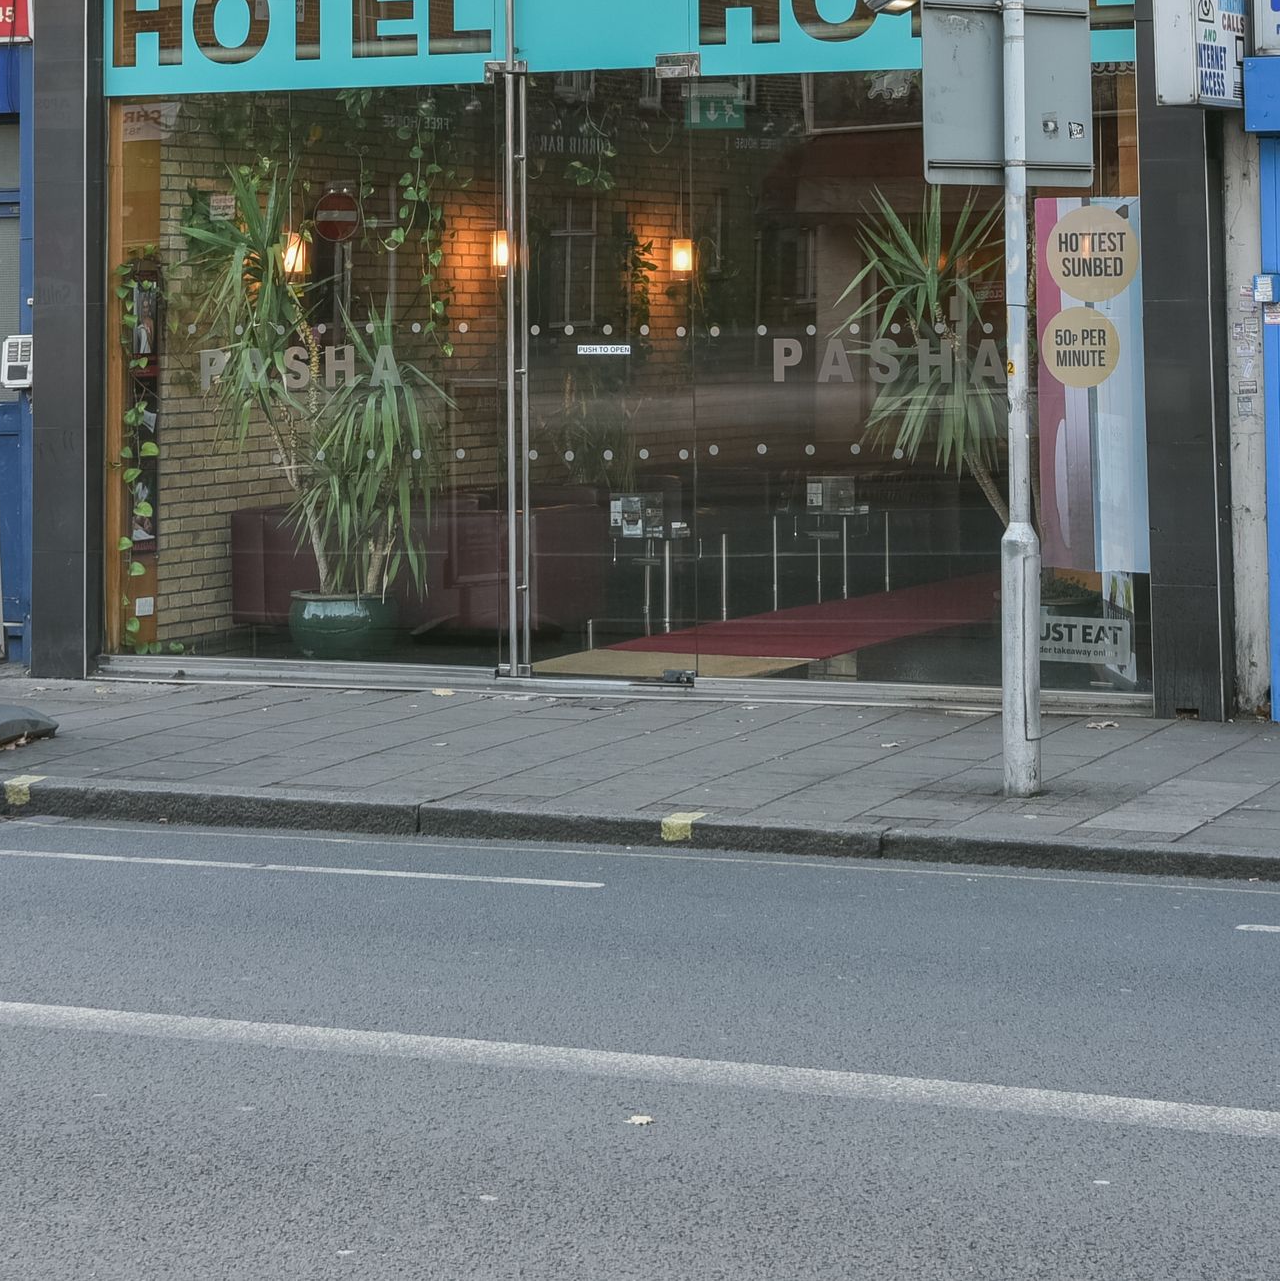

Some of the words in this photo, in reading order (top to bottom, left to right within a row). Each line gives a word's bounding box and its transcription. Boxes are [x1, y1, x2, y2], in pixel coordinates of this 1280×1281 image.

[1221, 13, 1245, 34] CALLS
[1204, 29, 1217, 43] AND
[1200, 69, 1226, 97] ACCESS
[1058, 232, 1127, 253] HOTTEST
[1062, 257, 1124, 277] SUNBED
[1081, 329, 1106, 346] PER
[199, 344, 403, 391] PASHA
[773, 338, 1007, 383] PASHA
[1007, 361, 1014, 374] 2
[1056, 350, 1106, 367] MINUTE
[1081, 625, 1123, 646] EAT
[1054, 646, 1092, 657] takeaway
